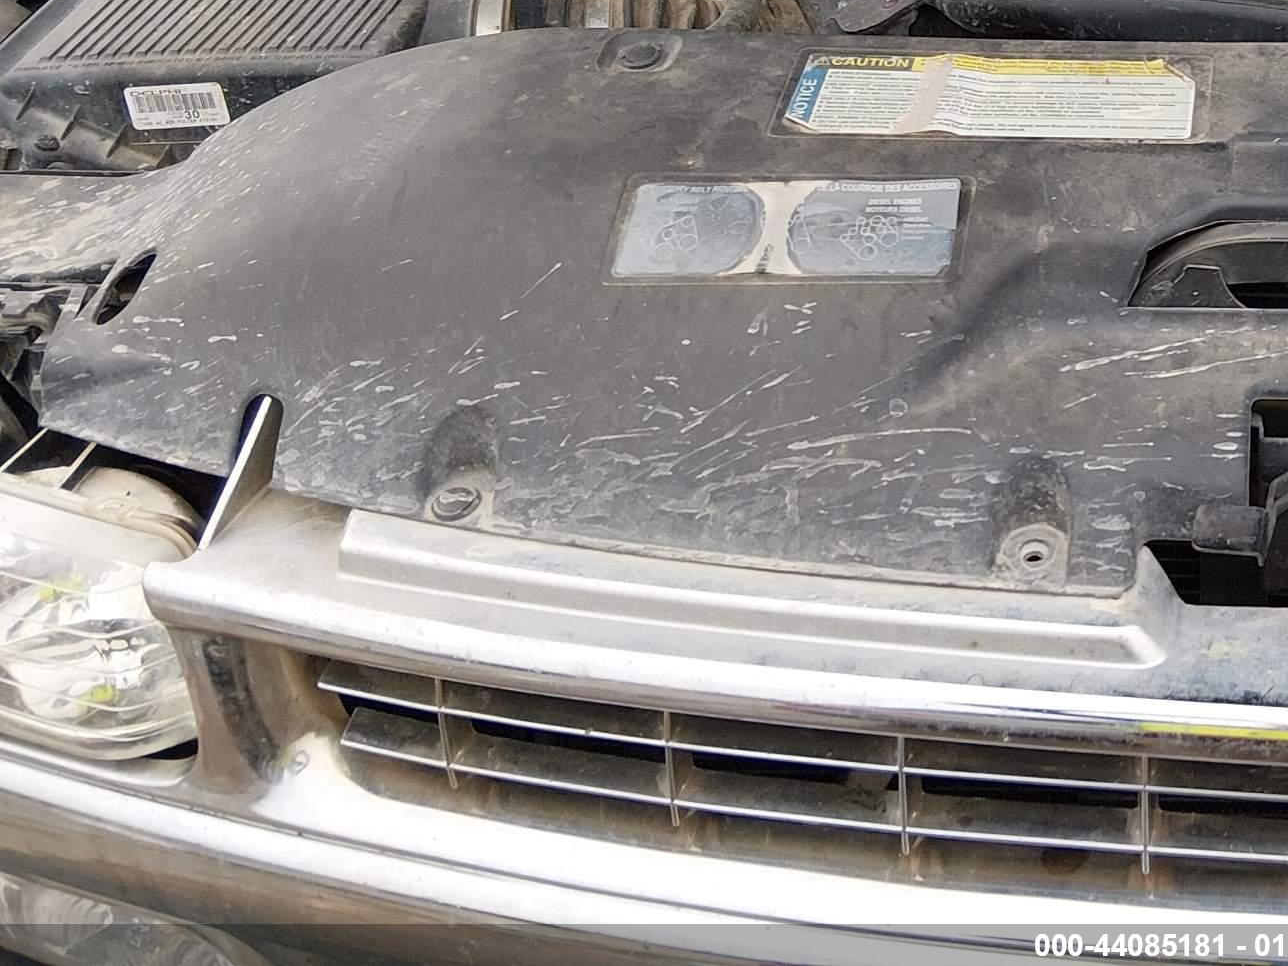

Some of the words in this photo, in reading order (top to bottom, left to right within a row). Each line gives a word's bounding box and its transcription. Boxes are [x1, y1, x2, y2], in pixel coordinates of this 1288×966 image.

[831, 56, 909, 69] CAUTION
[129, 88, 182, 97] DELPHI
[790, 77, 817, 119] NOTICE
[184, 109, 201, 120] 30
